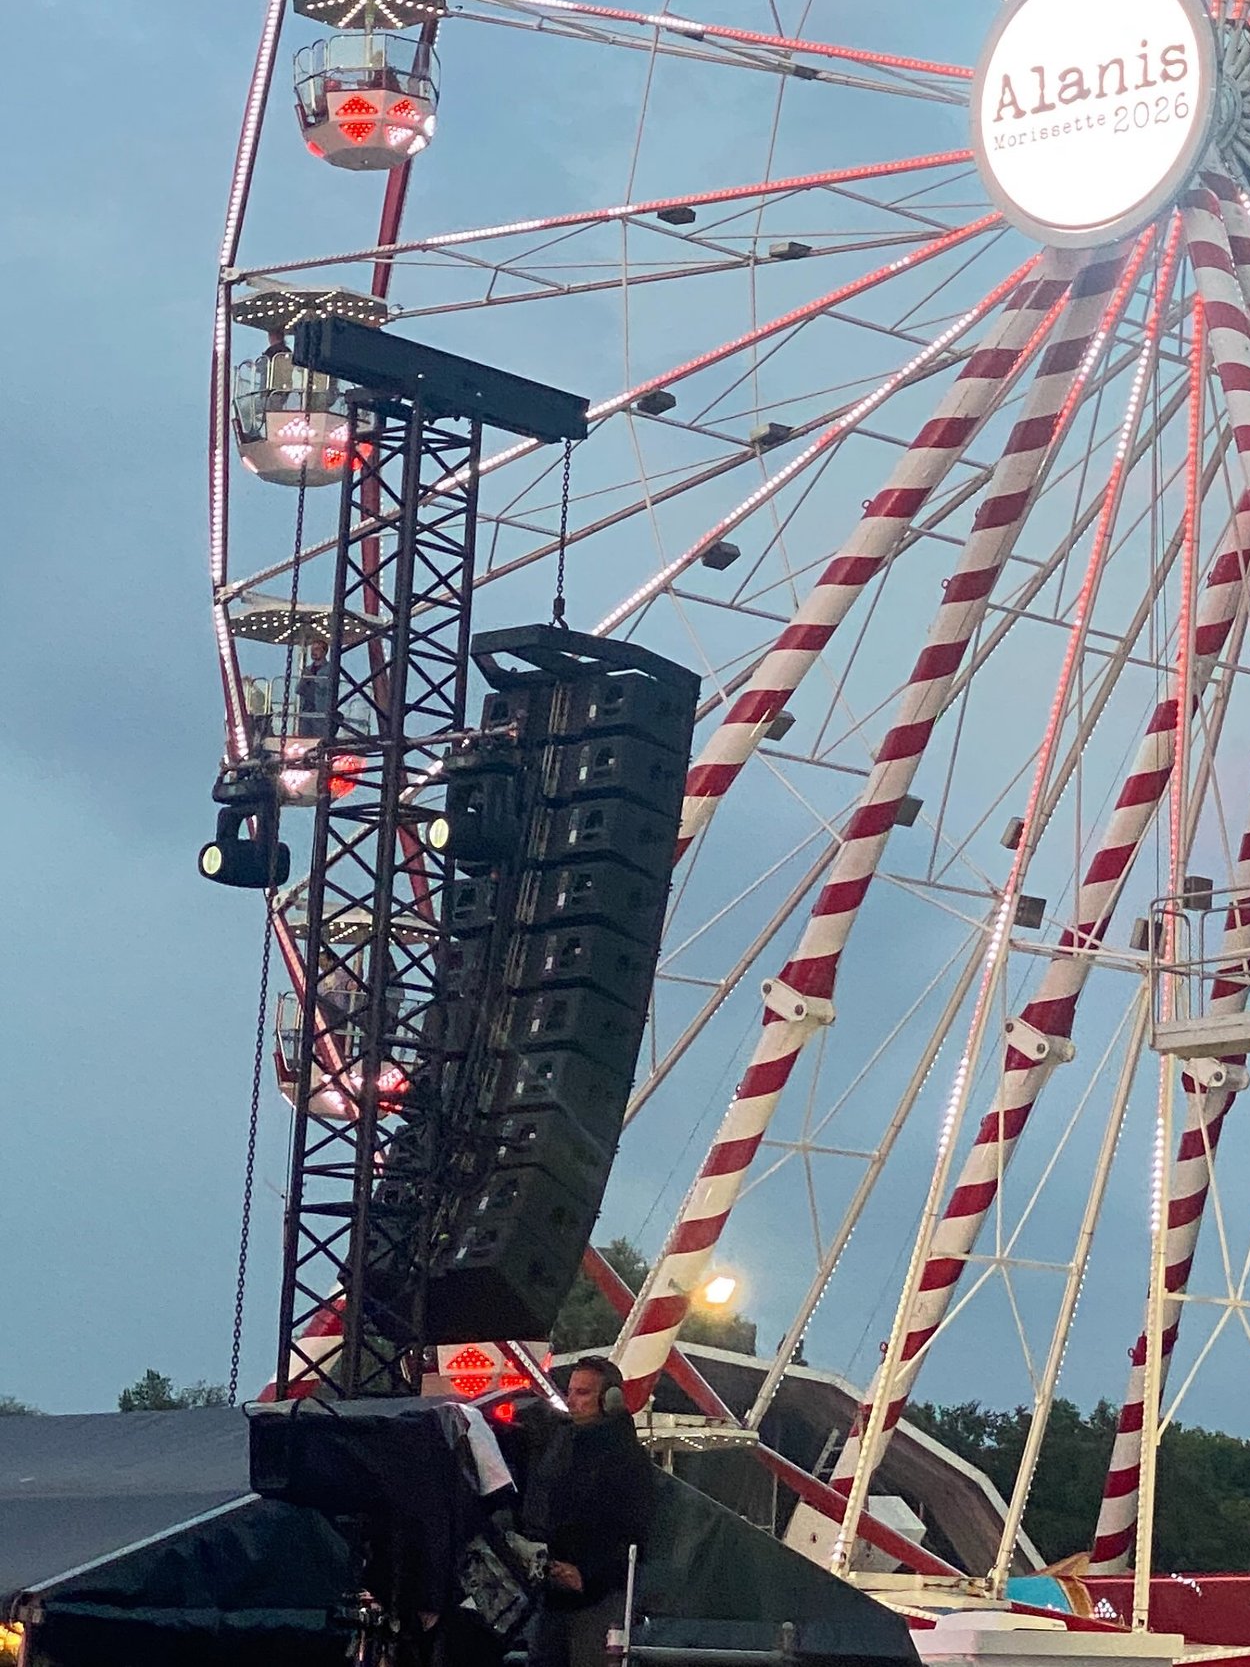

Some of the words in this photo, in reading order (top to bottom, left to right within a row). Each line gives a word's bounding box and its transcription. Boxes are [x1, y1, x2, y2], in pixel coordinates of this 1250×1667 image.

[993, 40, 1188, 122] Alanis
[994, 114, 1106, 150] Morissette
[1114, 92, 1189, 134] 2026
